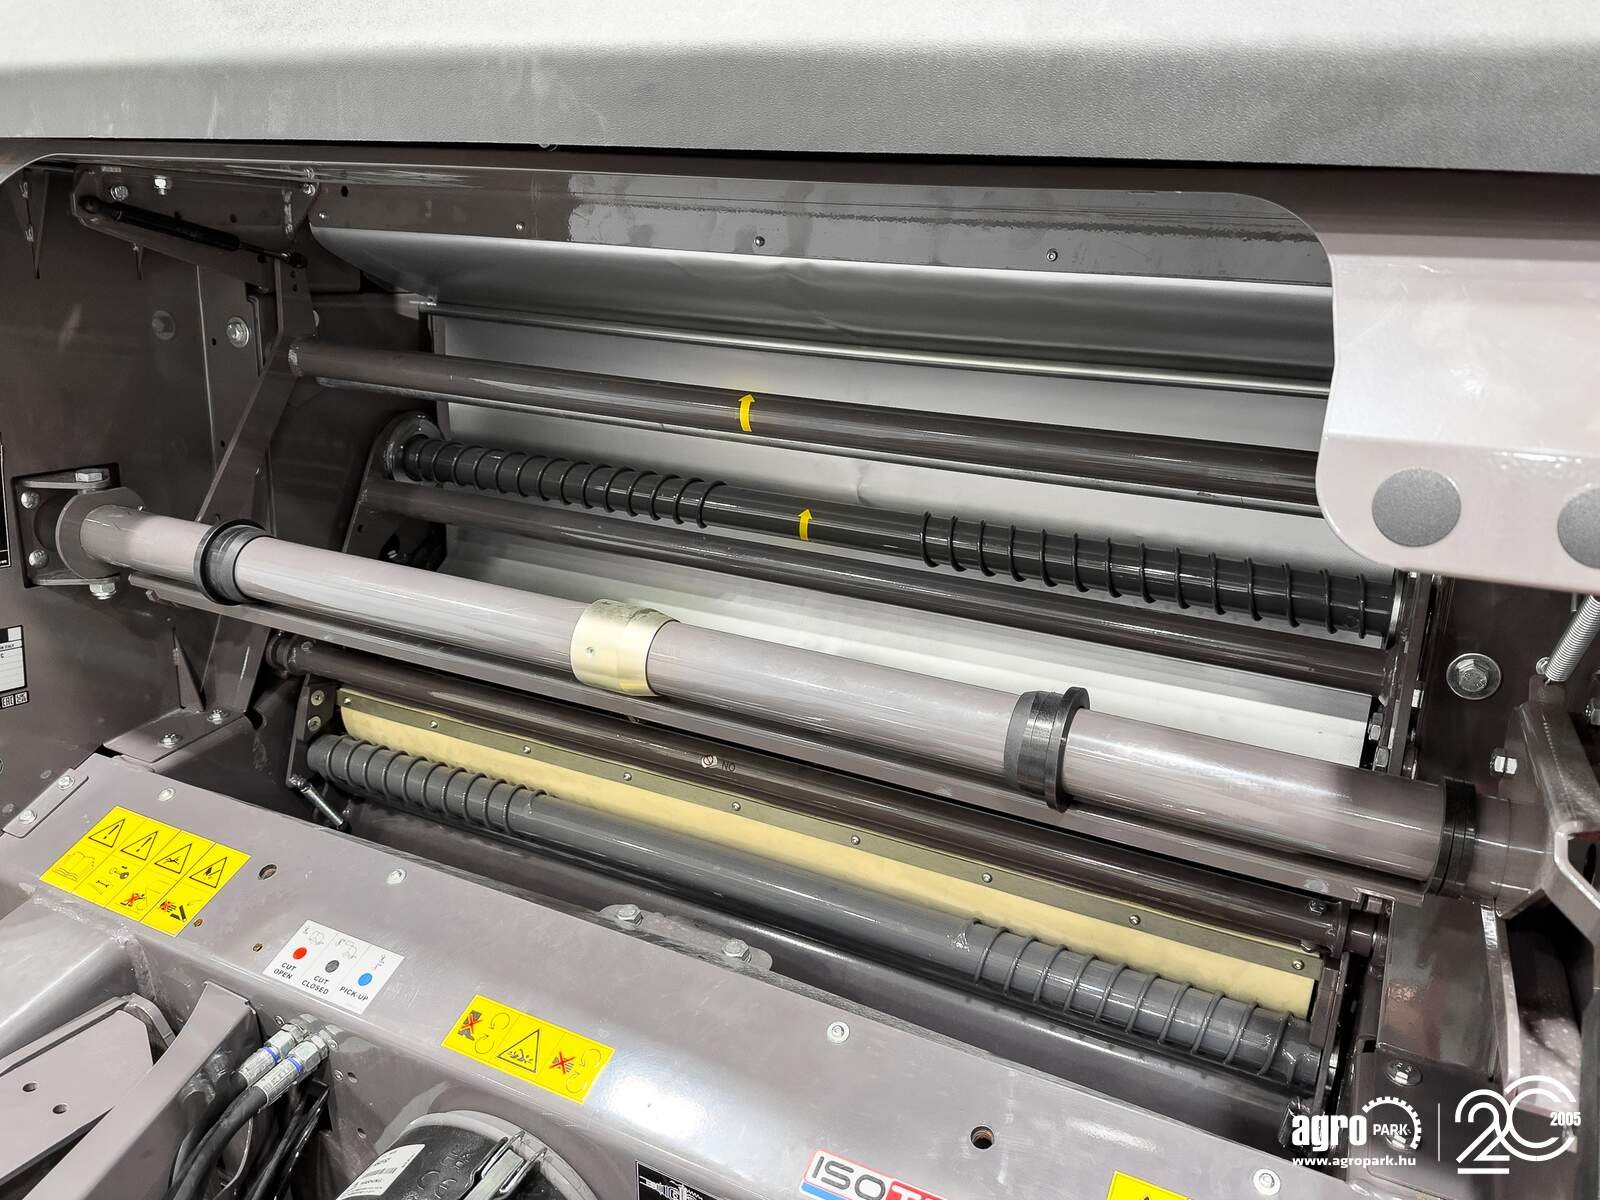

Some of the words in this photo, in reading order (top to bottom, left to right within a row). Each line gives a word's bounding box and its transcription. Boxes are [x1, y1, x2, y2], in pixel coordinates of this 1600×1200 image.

[281, 962, 297, 971] CUT
[273, 968, 293, 980] OPEN
[313, 975, 329, 985] CUT
[301, 979, 329, 995] CLOSED
[339, 986, 370, 1002] PICK-UP
